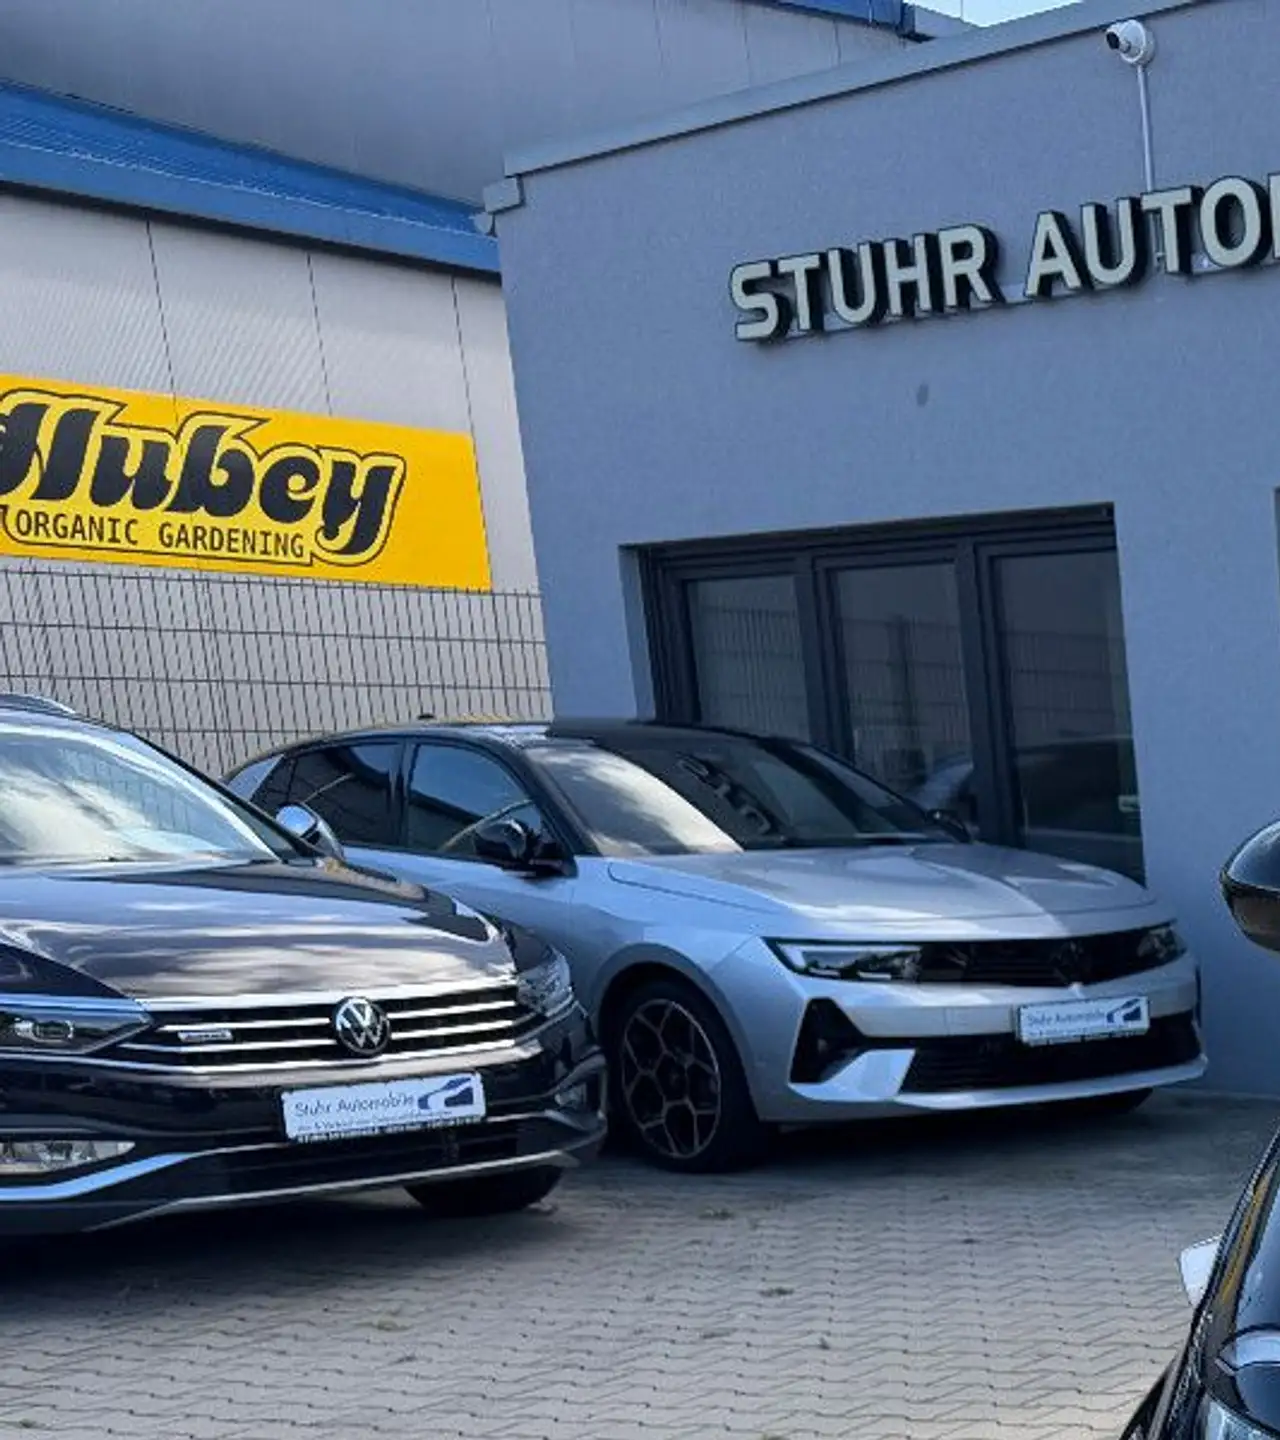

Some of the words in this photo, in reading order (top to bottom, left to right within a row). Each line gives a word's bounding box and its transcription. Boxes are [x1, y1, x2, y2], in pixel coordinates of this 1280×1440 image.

[730, 222, 1000, 343] STUHR
[16, 509, 139, 546] ORGANIC
[158, 522, 304, 558] GARDENING
